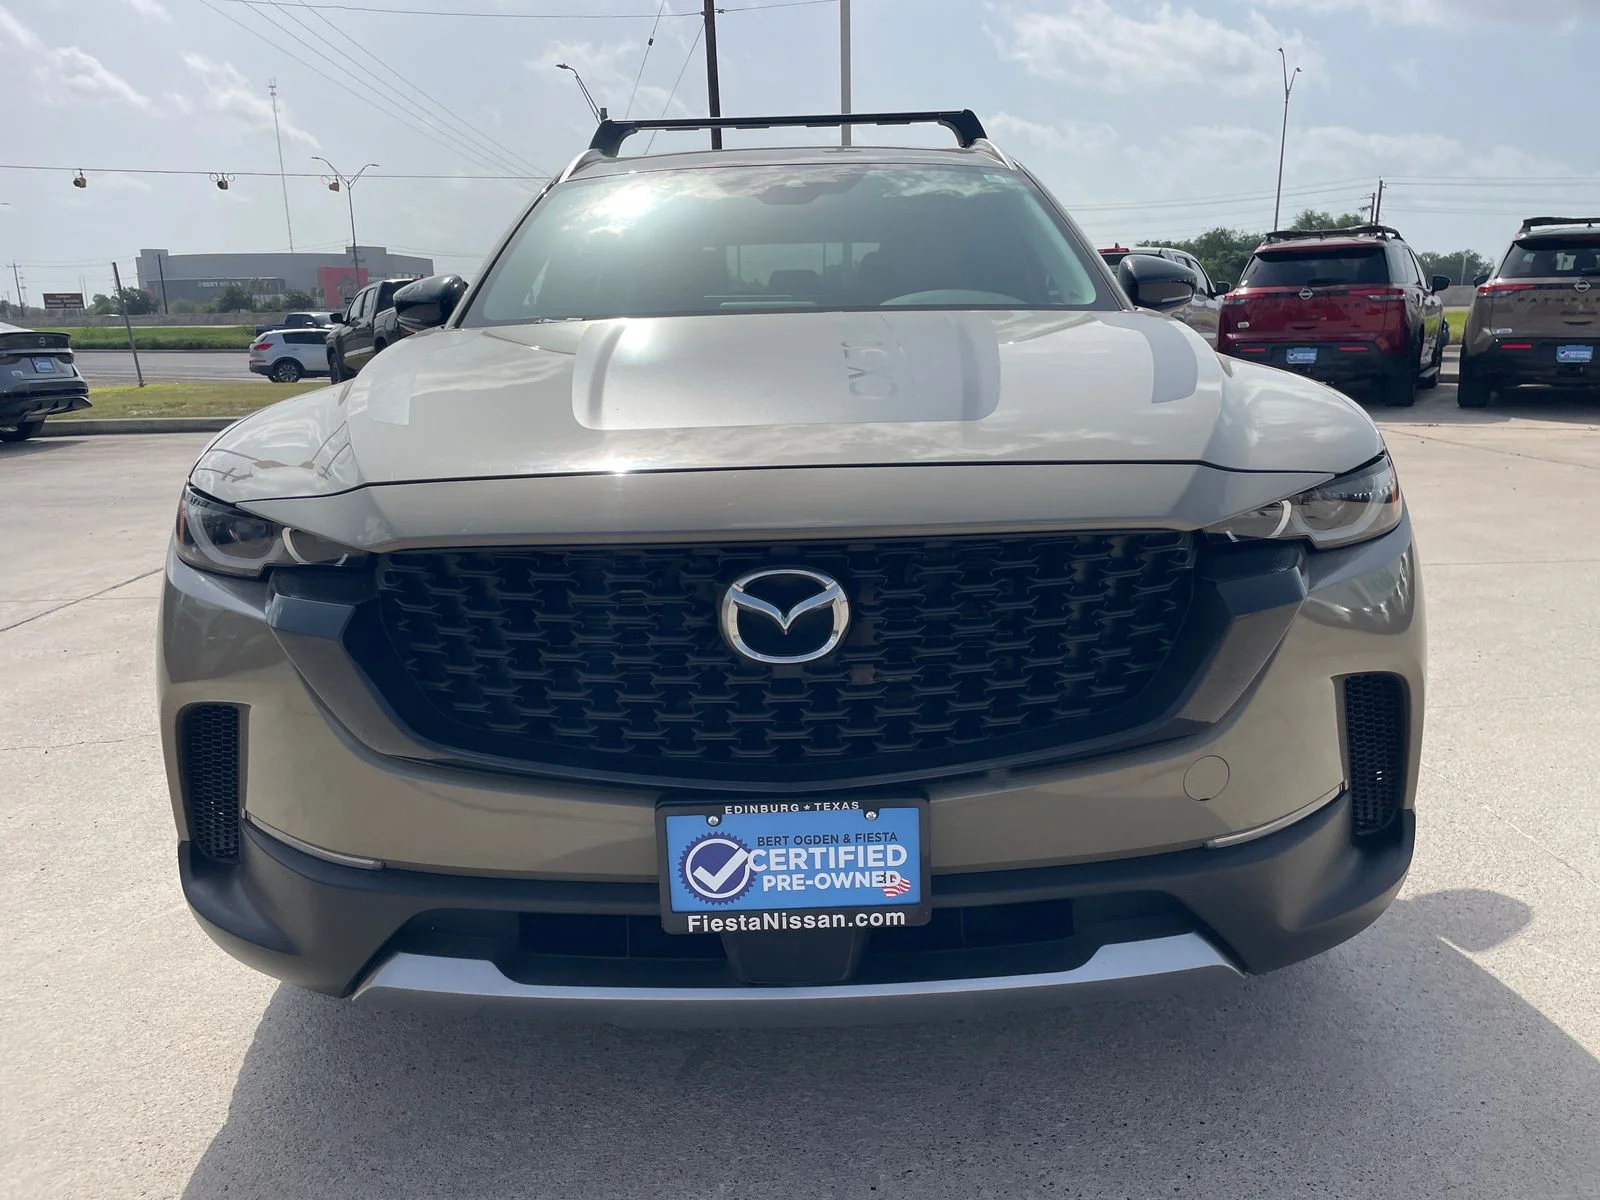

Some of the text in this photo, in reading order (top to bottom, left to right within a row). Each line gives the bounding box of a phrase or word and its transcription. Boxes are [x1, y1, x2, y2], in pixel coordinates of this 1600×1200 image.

[724, 801, 860, 814] EDINBURG TEXAS
[757, 832, 898, 847] BERT OGDEN & FIESTA
[749, 844, 908, 872] CERTIFIED
[763, 870, 902, 892] PRE-OWNED
[687, 911, 906, 933] FiestaNissan.com
